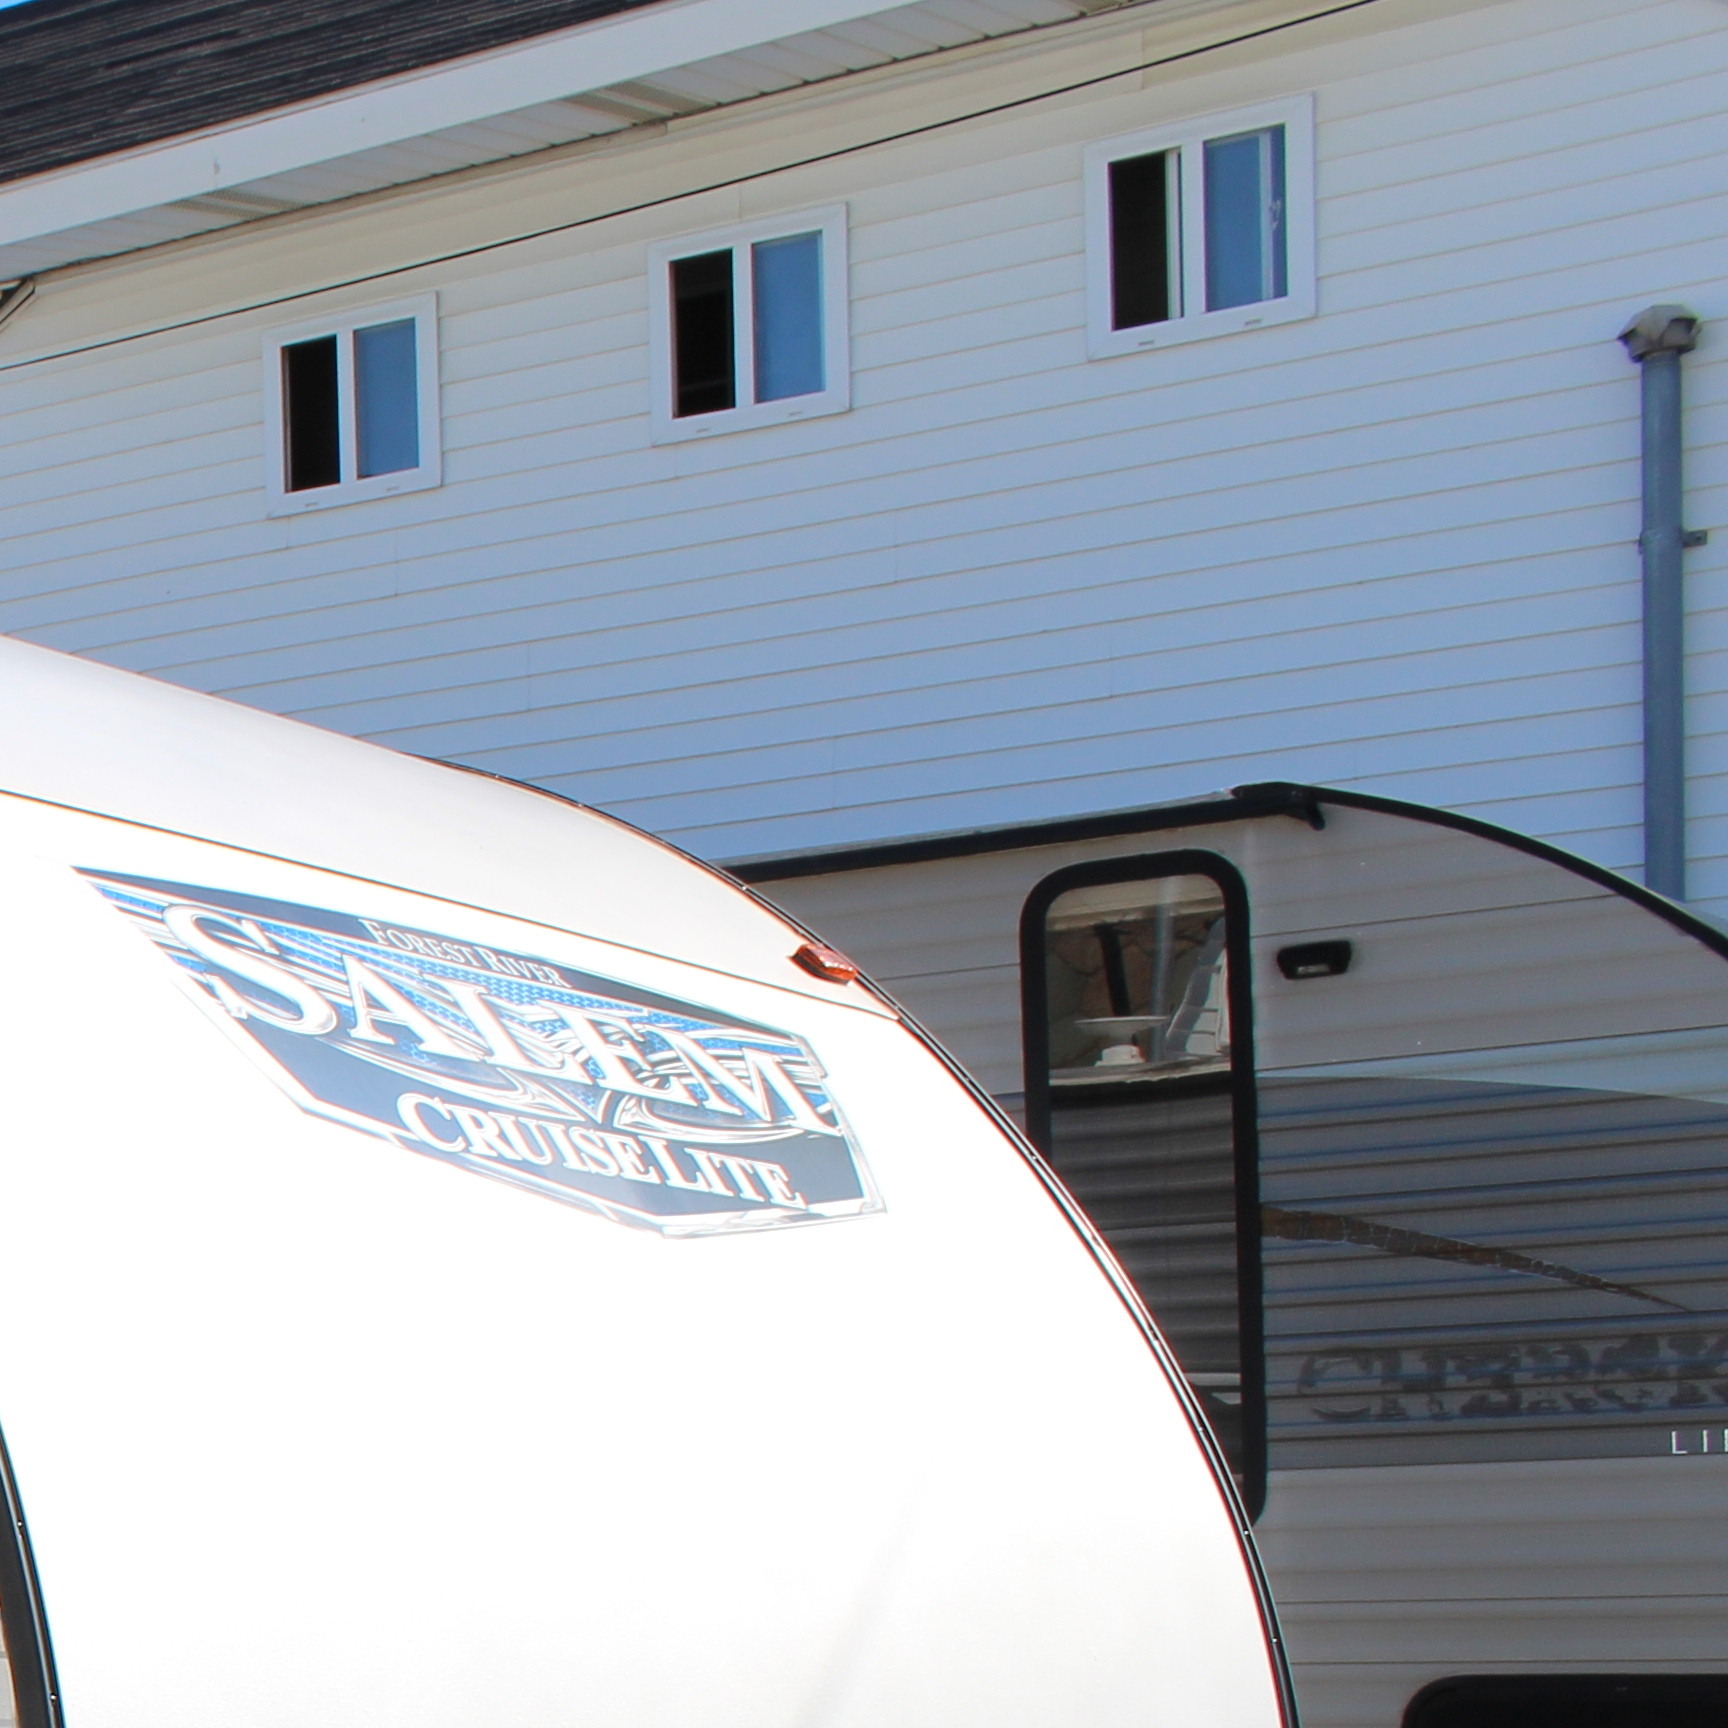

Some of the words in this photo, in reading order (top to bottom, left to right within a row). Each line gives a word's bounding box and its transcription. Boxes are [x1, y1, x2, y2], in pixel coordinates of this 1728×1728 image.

[357, 917, 483, 968] FOREST
[473, 946, 572, 988] RIVER
[162, 902, 845, 1138] SALEM
[1671, 1428, 1728, 1455] LI
